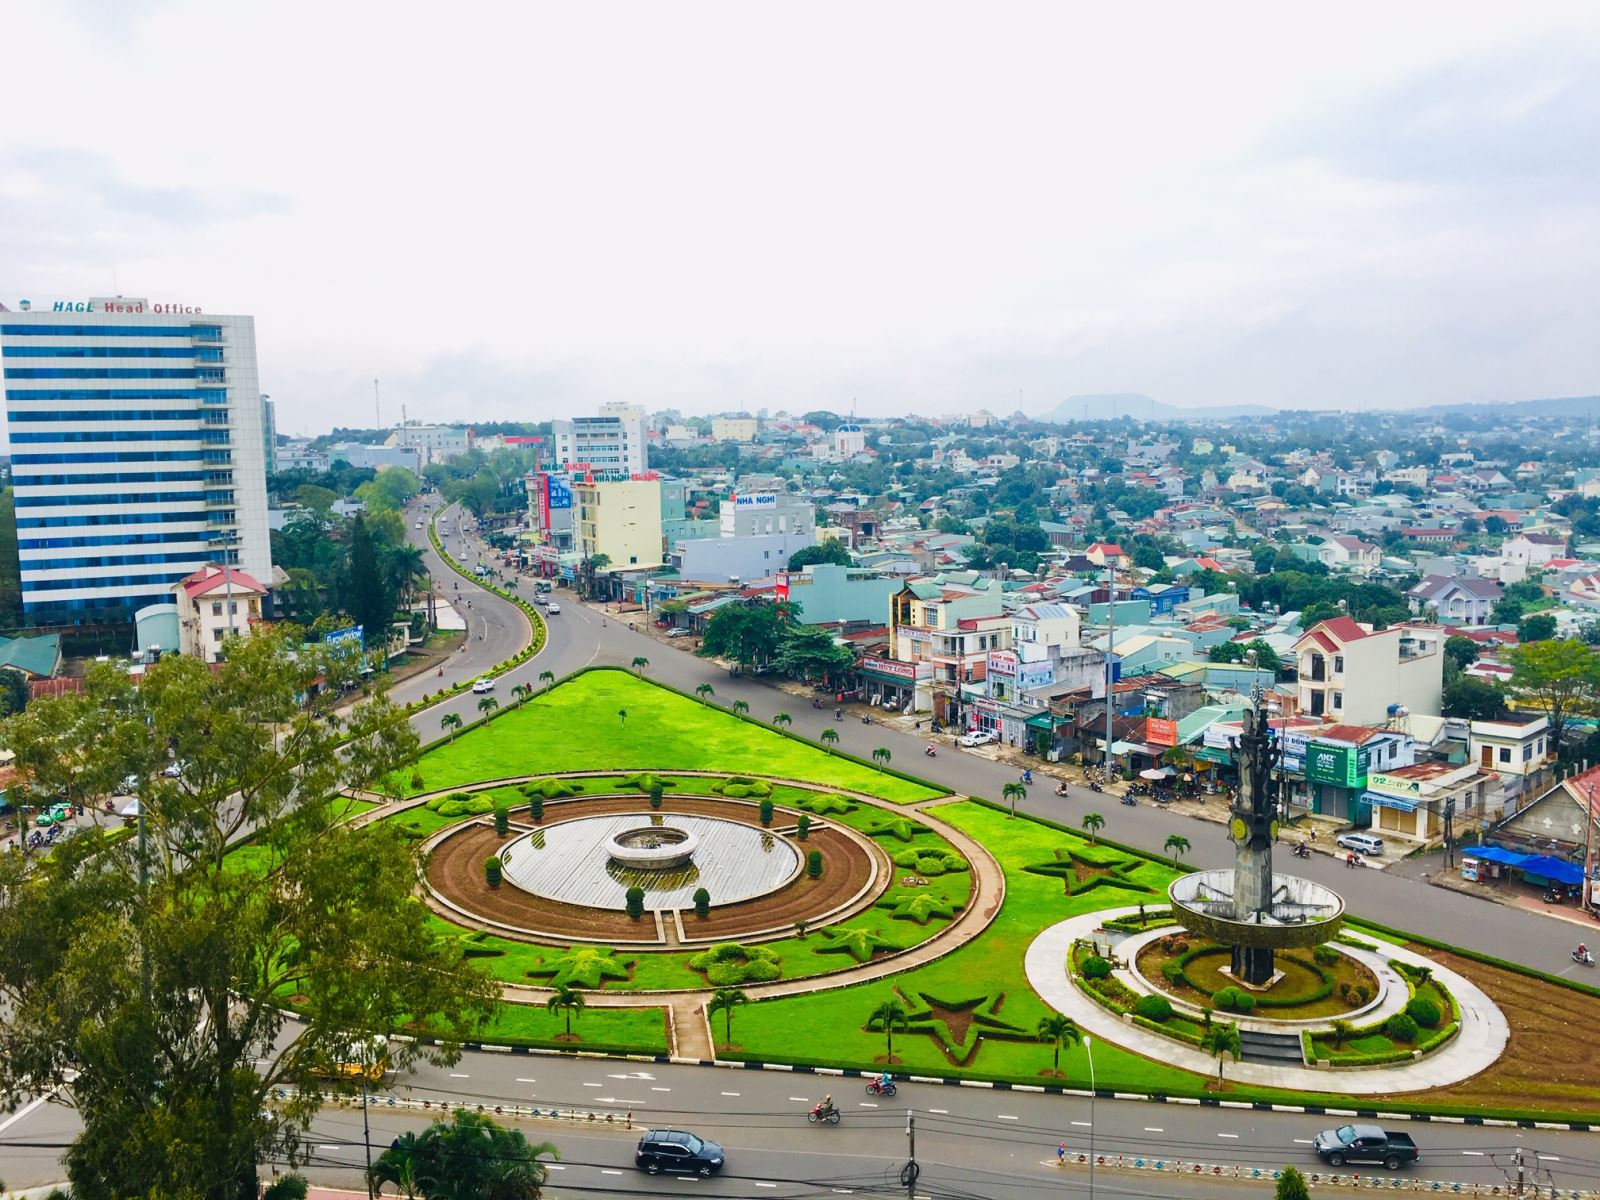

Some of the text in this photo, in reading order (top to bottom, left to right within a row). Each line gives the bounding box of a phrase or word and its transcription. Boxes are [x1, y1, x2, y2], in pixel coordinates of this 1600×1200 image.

[53, 301, 203, 315] HAGL Head Office
[878, 663, 894, 672] HUY
[894, 667, 913, 676] LONG
